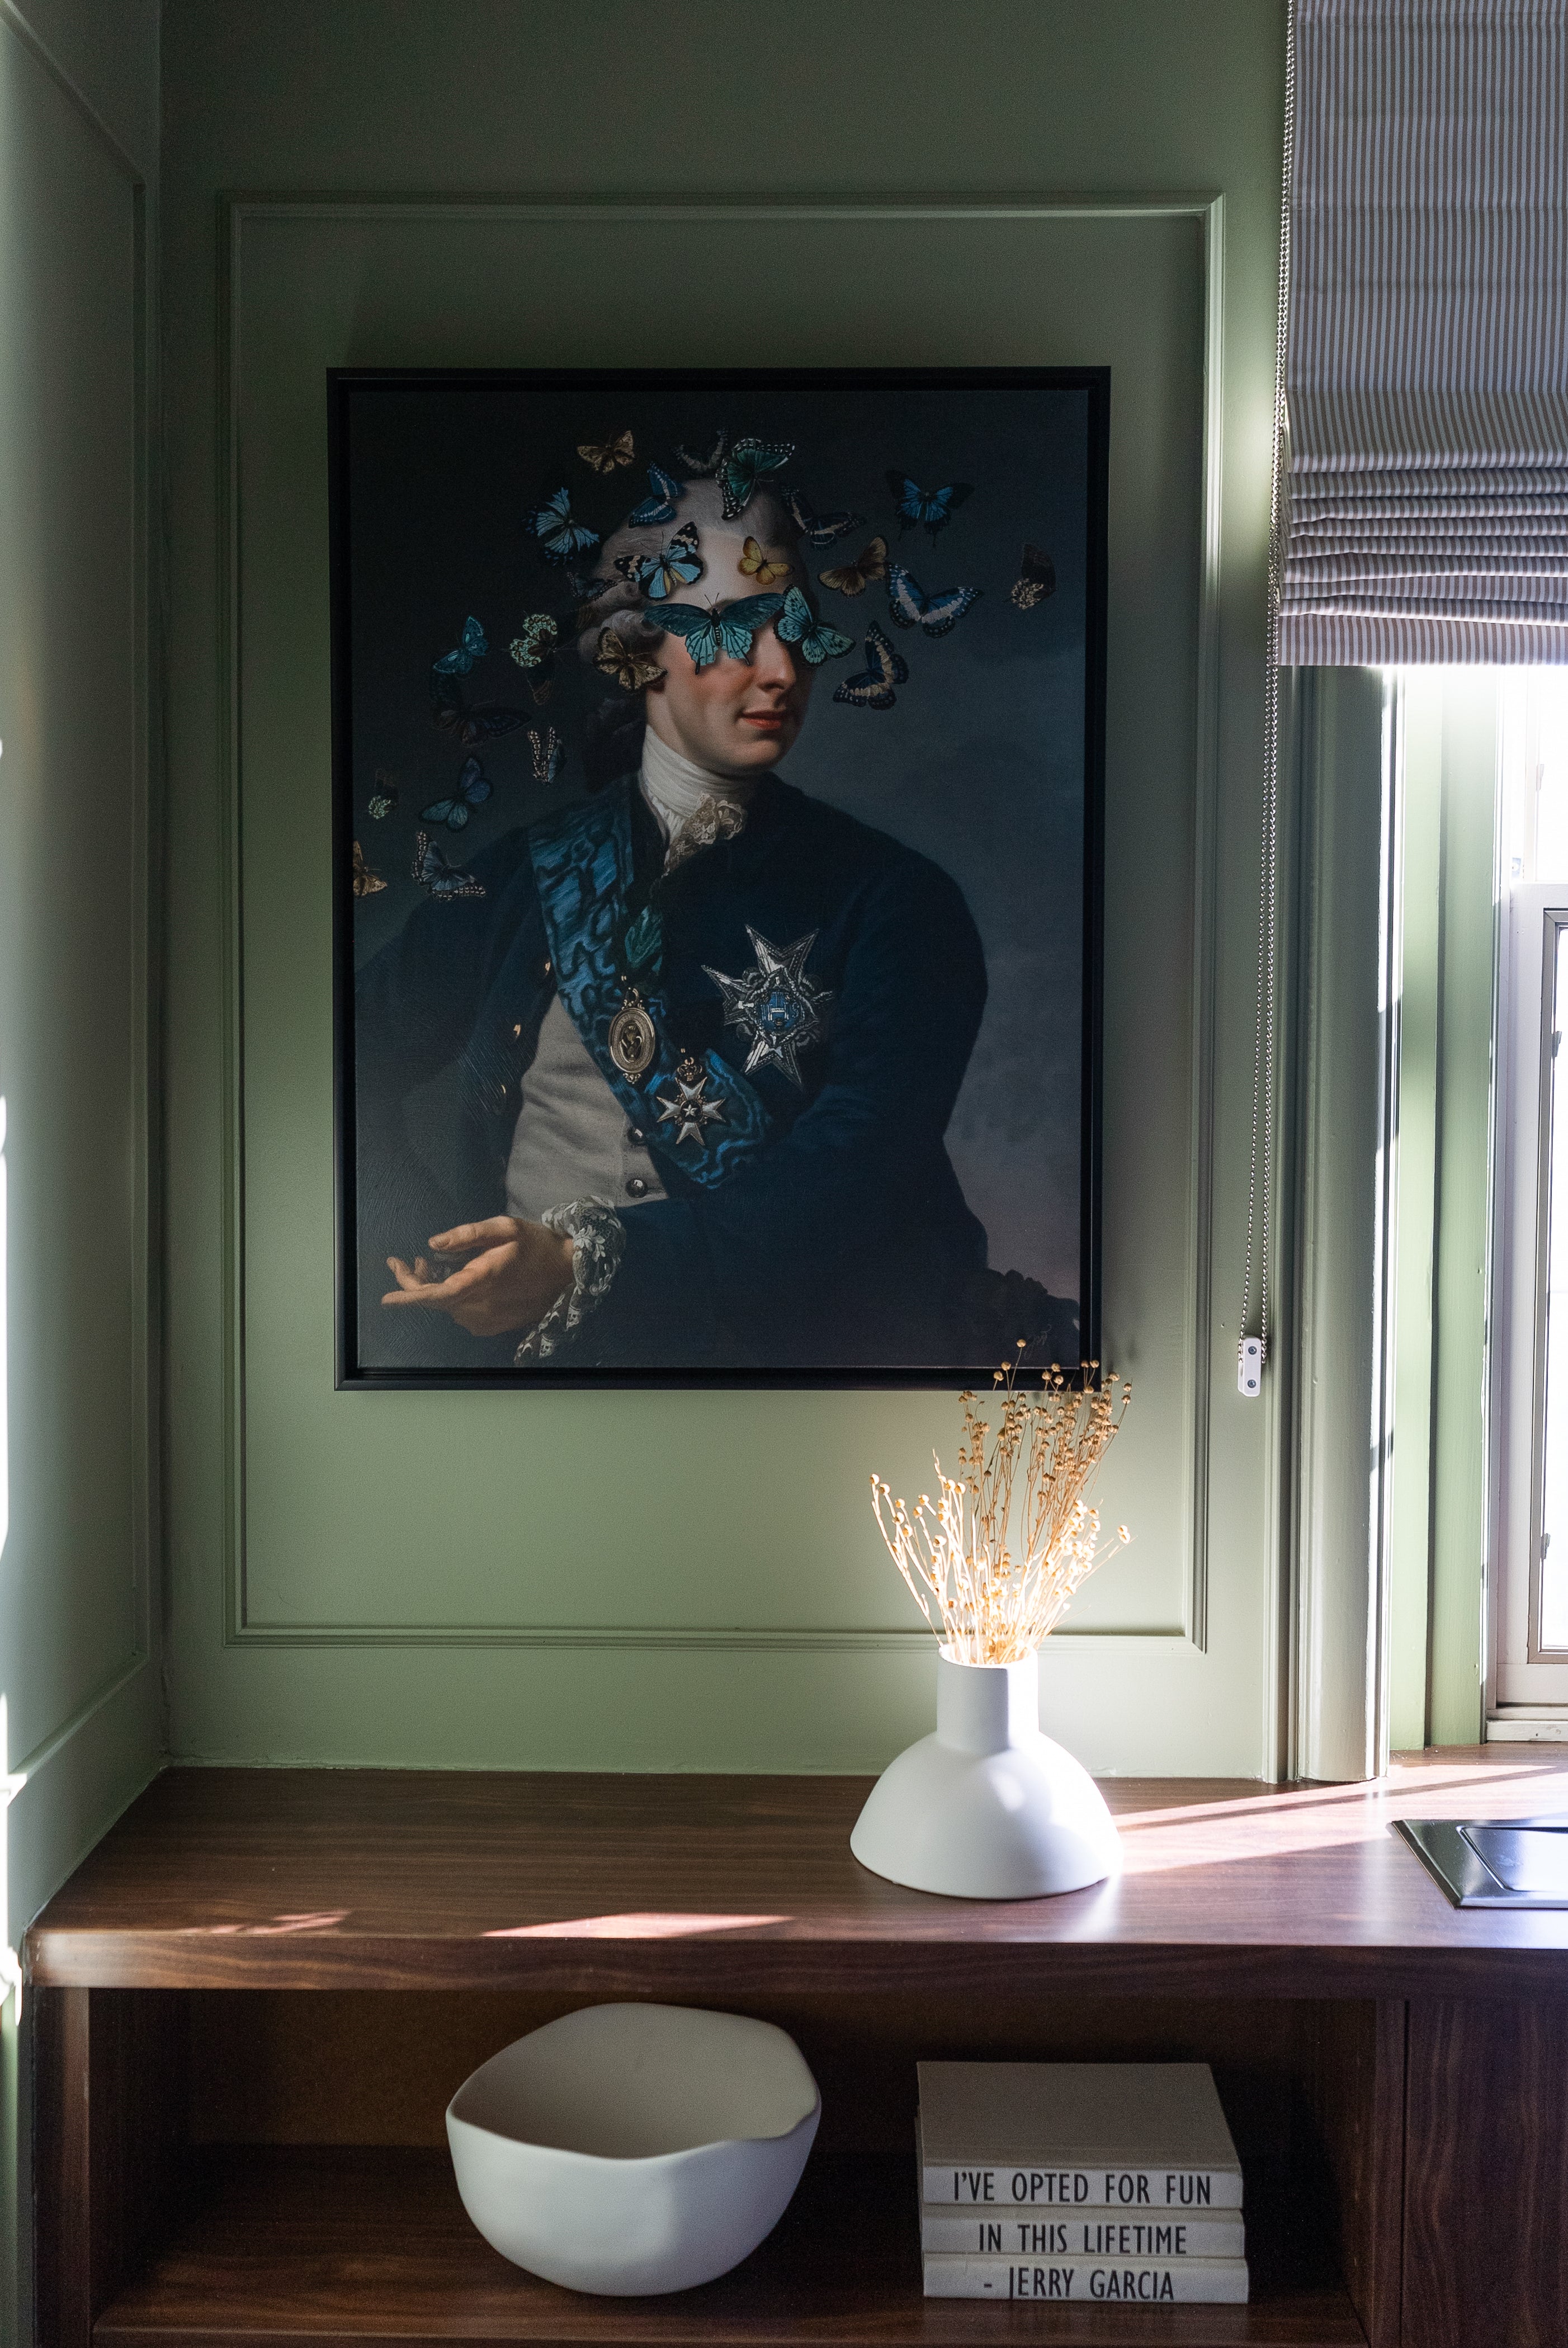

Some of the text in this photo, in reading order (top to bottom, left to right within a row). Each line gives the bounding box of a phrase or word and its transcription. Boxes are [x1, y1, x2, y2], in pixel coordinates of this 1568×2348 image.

[954, 2172, 1211, 2205] I'VE OPTED FOR FUN
[979, 2224, 1187, 2255] IN THIS LIFETIME
[1009, 2267, 1075, 2299] JERRY
[1089, 2270, 1174, 2301] GARCIA
